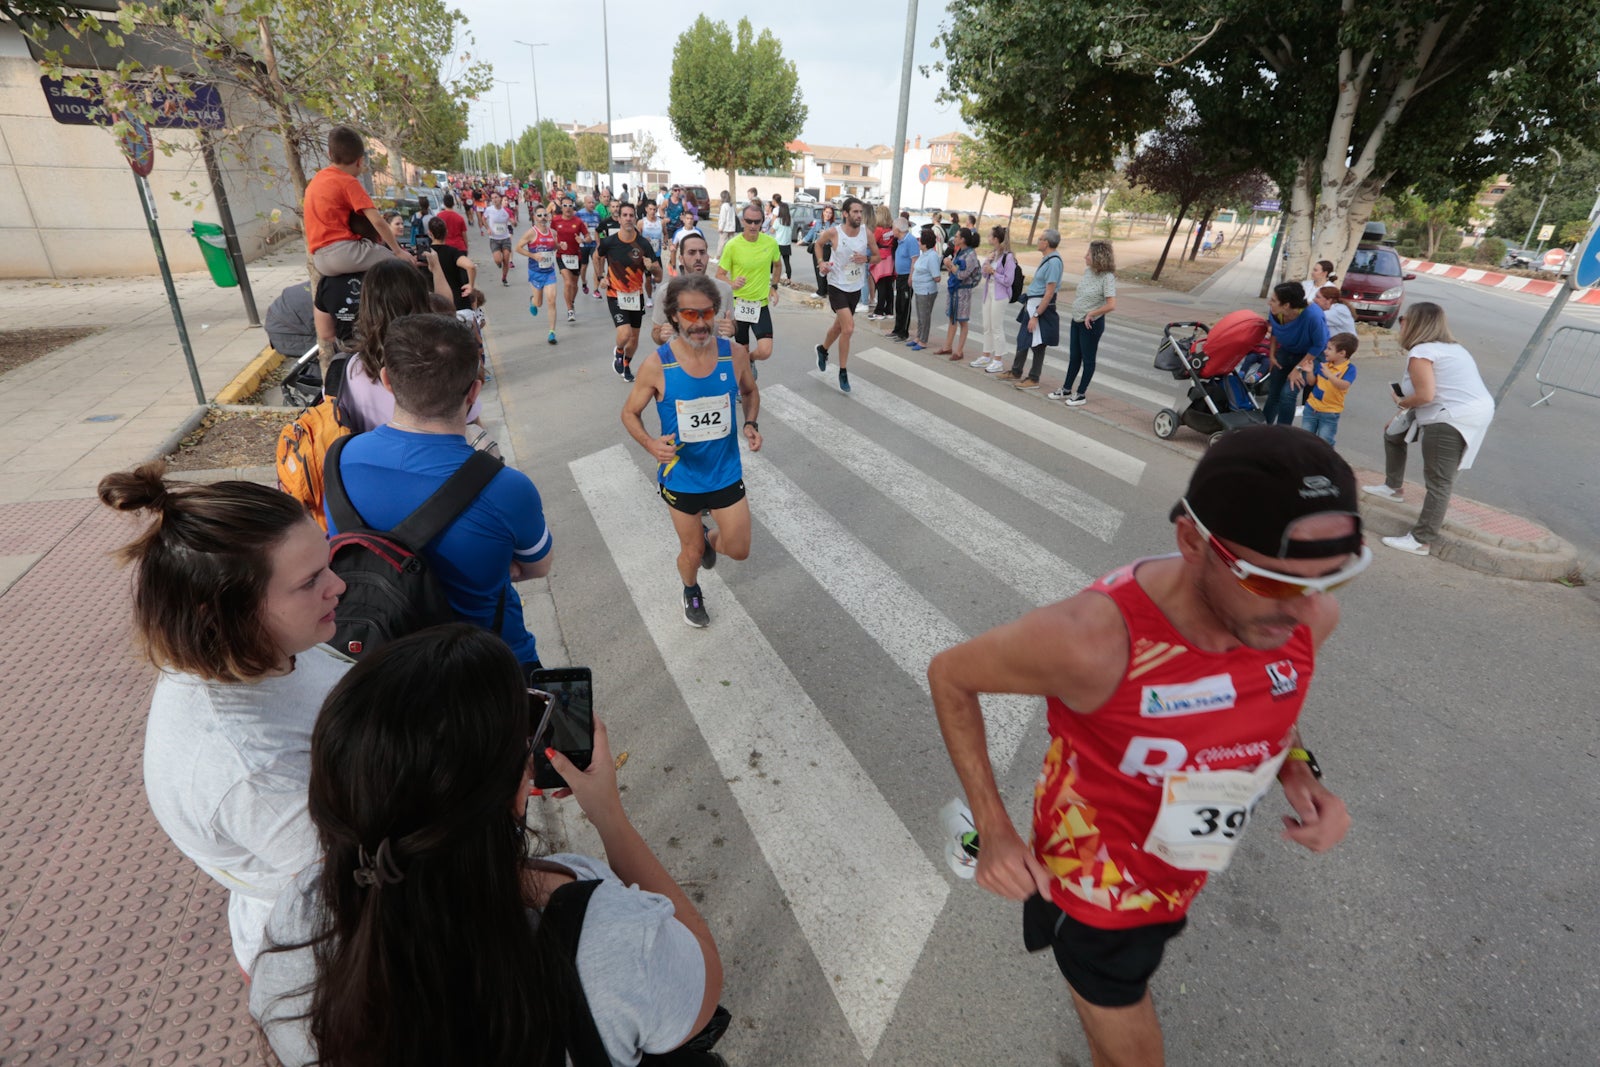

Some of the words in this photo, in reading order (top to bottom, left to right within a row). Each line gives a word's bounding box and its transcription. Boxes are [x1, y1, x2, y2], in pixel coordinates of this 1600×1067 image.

[740, 306, 755, 315] 336
[690, 411, 721, 428] 342
[1190, 804, 1249, 838] 39
